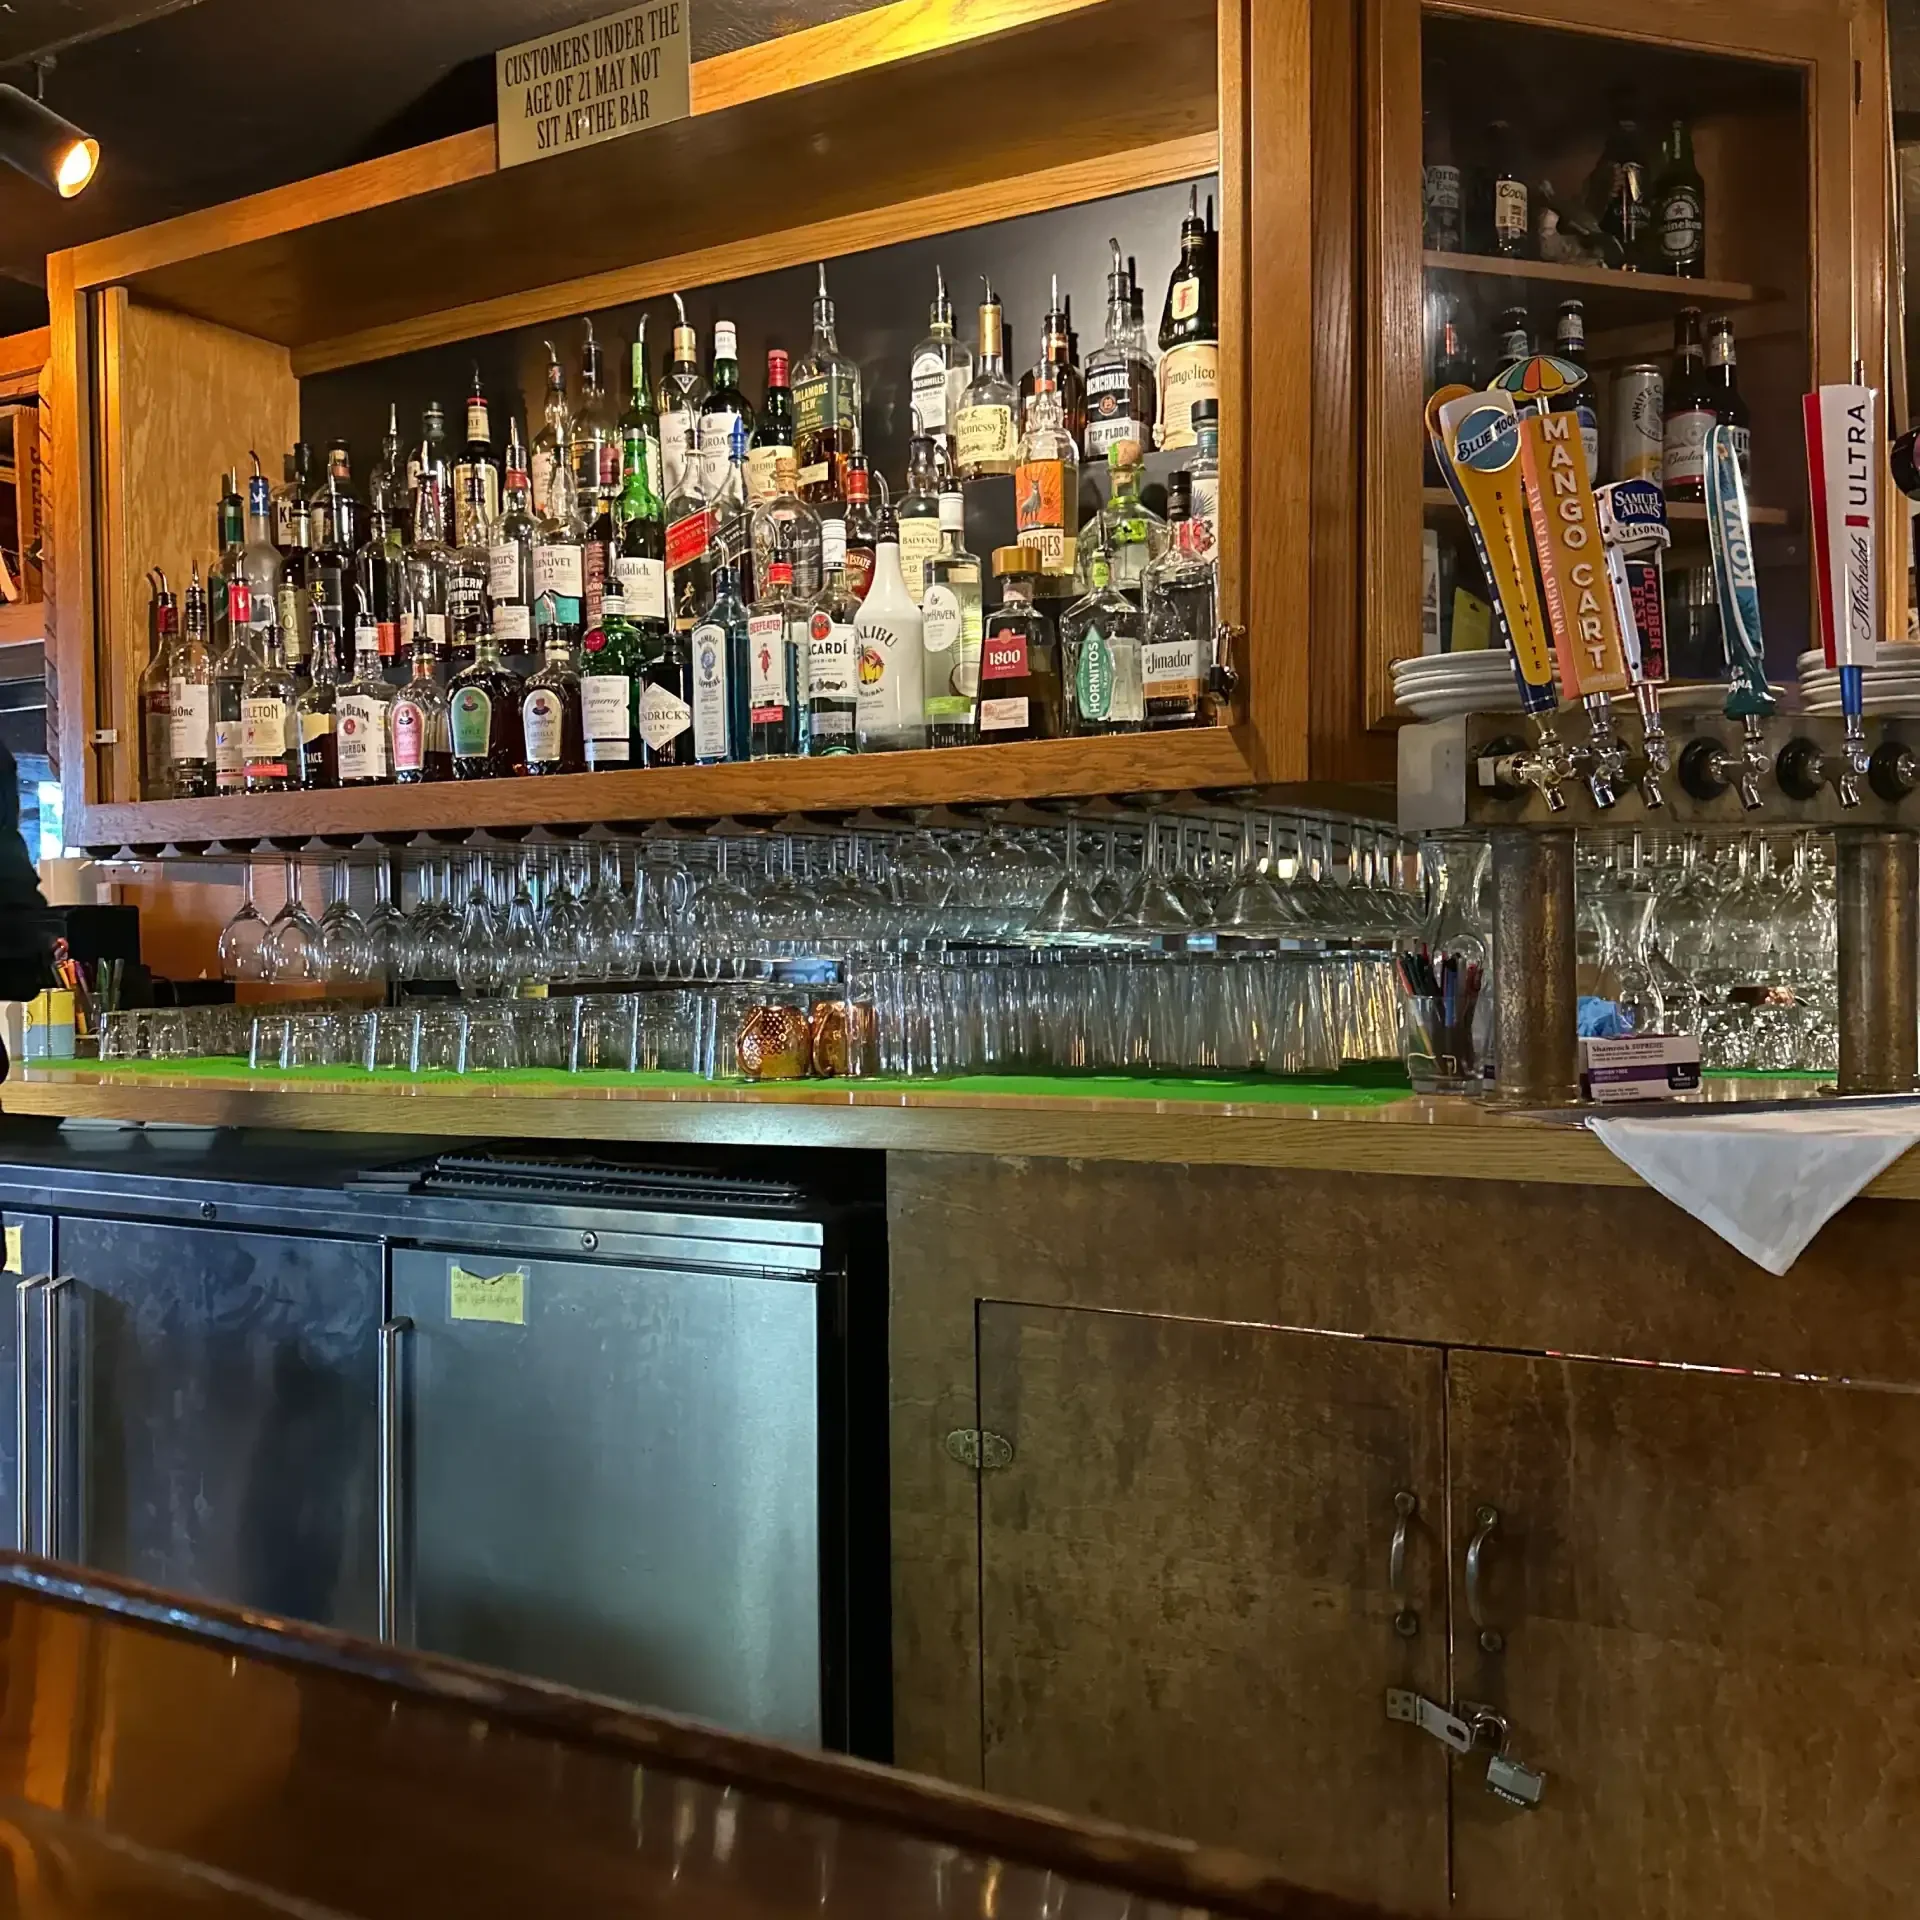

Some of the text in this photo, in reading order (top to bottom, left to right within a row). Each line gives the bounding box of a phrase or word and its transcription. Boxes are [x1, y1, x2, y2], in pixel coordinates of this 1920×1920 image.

[505, 2, 680, 87] CUSTOMERS UNDER THE
[525, 47, 661, 118] AGE OF 21 MAY NOT
[537, 89, 650, 149] SIT AT THE BAR
[792, 382, 829, 405] TULLAMORE
[913, 375, 945, 389] BUSHMILLS
[1086, 372, 1131, 397] BENCHMARK
[1632, 386, 1654, 421] WHITE
[958, 422, 997, 437] Hennessy
[1089, 425, 1130, 442] TOP FLOOR
[1457, 432, 1492, 462] BLUE
[1847, 401, 1867, 507] ULTRA
[1614, 490, 1663, 507] SAMUEL
[1620, 501, 1662, 519] ADAMS
[1543, 416, 1606, 671] MANGO CART
[1619, 524, 1665, 538] SEASONAL
[1724, 498, 1756, 588] KONA
[850, 554, 872, 569] ESTATE
[909, 564, 917, 573] 12
[1529, 484, 1565, 635] MANGO WHEAT ALE
[543, 567, 554, 579] 12
[1495, 491, 1542, 670] BELGIAN WHITE
[1851, 533, 1870, 641] Michelob
[1632, 586, 1647, 631] FEST
[1643, 567, 1661, 649] OCTOBER
[749, 619, 781, 635] BEEFEATER
[989, 649, 1021, 665] 1800
[1147, 650, 1194, 675] Jimador
[1088, 641, 1101, 715] HORNITOS
[346, 703, 370, 723] BEAM
[1592, 1042, 1630, 1053] Shamrock
[1676, 1066, 1685, 1077] L
